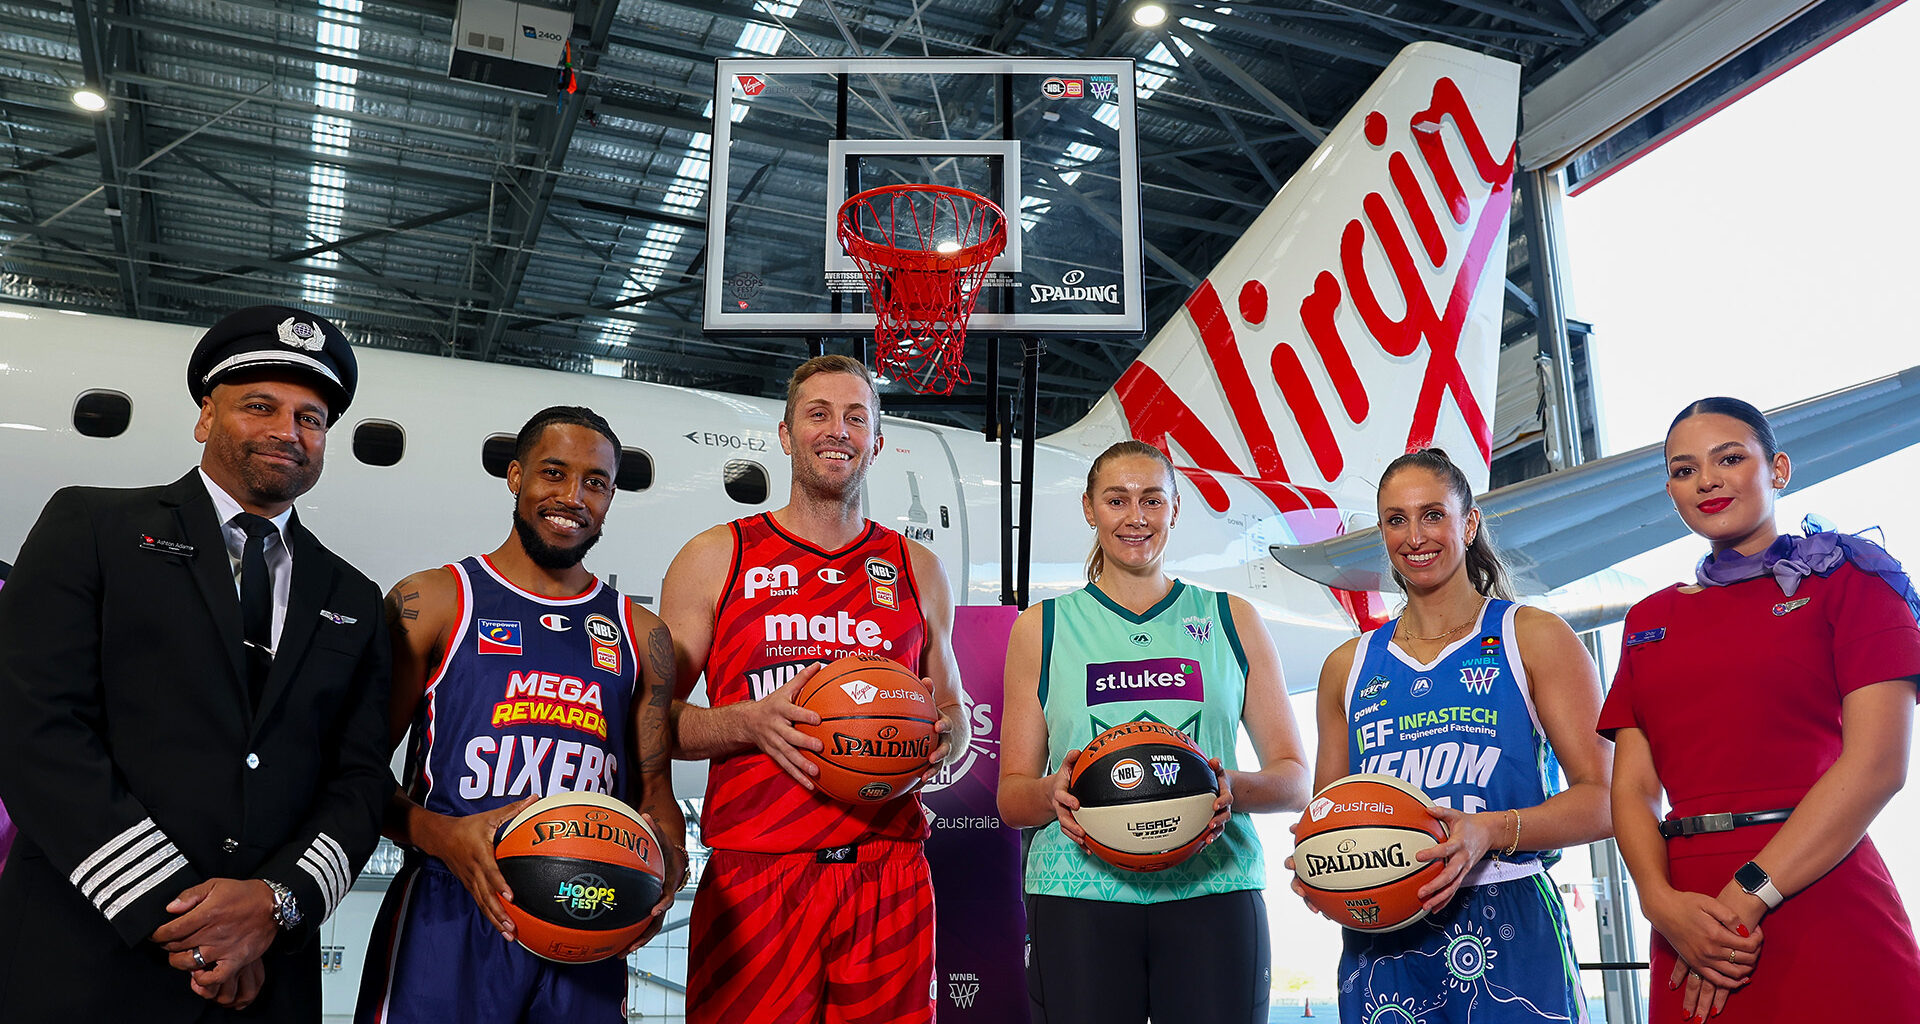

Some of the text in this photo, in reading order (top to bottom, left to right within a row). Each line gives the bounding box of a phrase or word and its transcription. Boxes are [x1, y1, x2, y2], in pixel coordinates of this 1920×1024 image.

[538, 31, 562, 41] 2400
[1047, 83, 1062, 93] NBL
[1113, 76, 1516, 514] Virgin
[703, 432, 767, 453] E190-E2
[871, 564, 893, 578] NBL
[770, 587, 799, 597] bank
[481, 620, 518, 629] Tyrepower
[592, 621, 614, 639] NBL
[765, 610, 892, 651] mate.
[765, 644, 822, 658] internet
[1462, 656, 1500, 667] WNBL
[1095, 669, 1186, 692] st.lukes
[505, 673, 603, 712] MEGA
[851, 683, 873, 700] Virgin
[880, 689, 925, 703] australia
[492, 702, 607, 738] REWARDS
[1354, 702, 1380, 722] gawk
[1399, 707, 1498, 731] INFASTECH
[1400, 723, 1497, 741] Engineered Fastening
[831, 732, 930, 758] SPALDING
[1088, 724, 1195, 758] SPALDING
[1151, 754, 1179, 762] WNBL
[459, 735, 618, 800] SIXERS
[1117, 766, 1137, 781] NBL
[1334, 800, 1394, 815] australia
[936, 815, 1000, 829] australia
[1127, 815, 1181, 831] LEGACY
[531, 820, 651, 865] SPALDING
[558, 881, 616, 902] HOOPS
[570, 897, 600, 910] FEST
[1345, 898, 1377, 907] WNBL
[949, 973, 979, 981] WNBL
